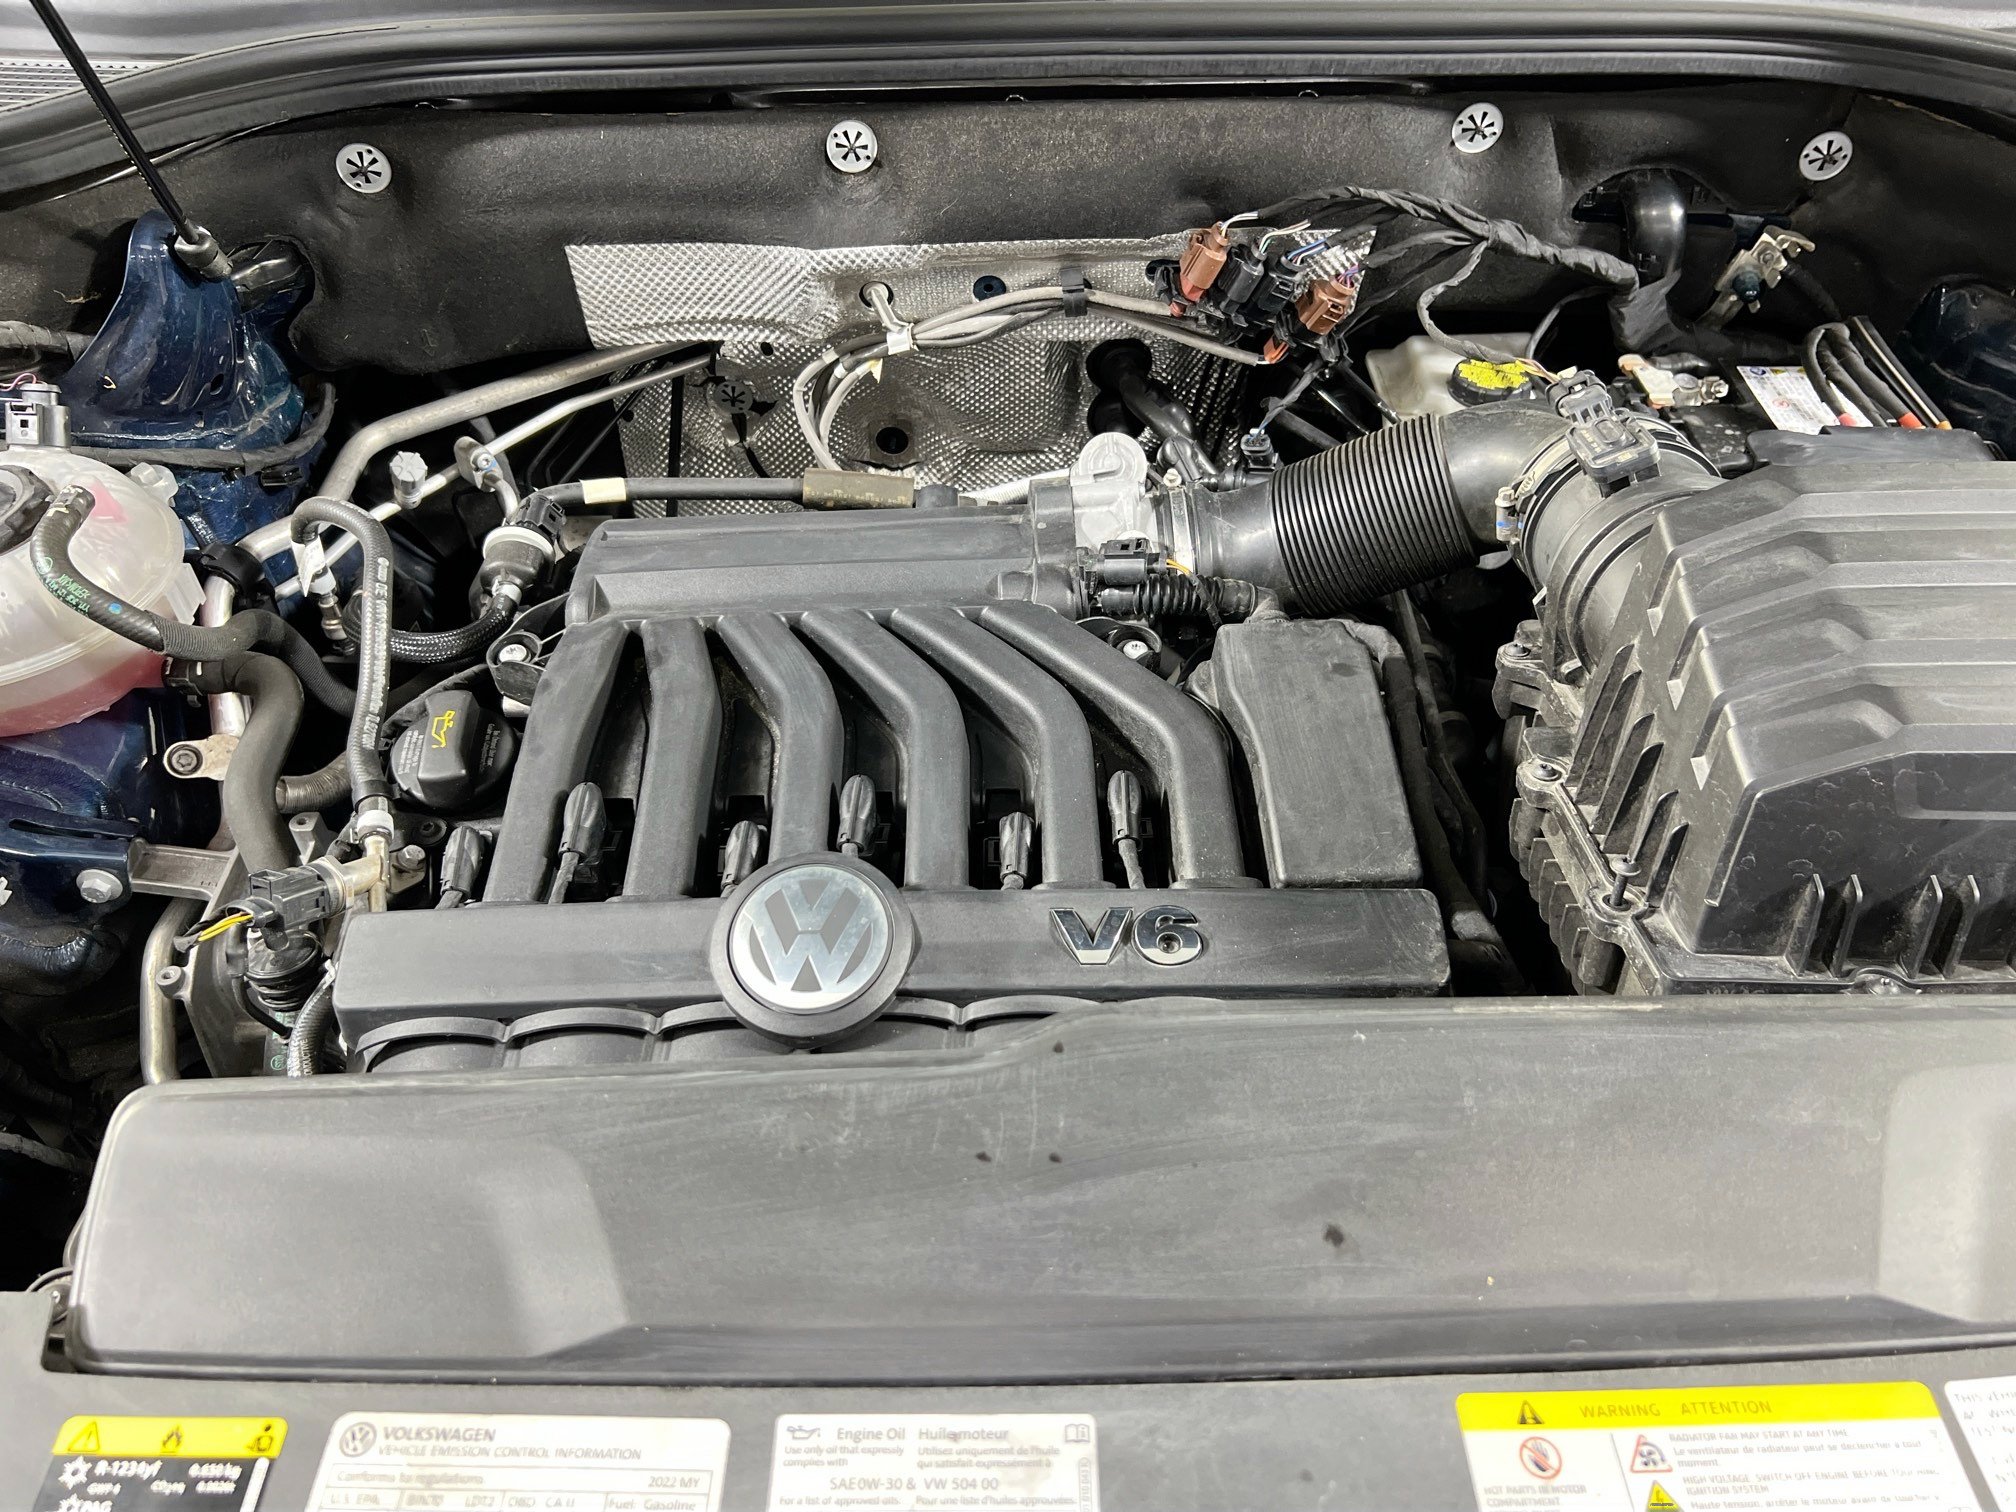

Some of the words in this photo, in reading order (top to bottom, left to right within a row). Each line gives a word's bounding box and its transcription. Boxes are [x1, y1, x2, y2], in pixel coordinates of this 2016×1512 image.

[1050, 906, 1203, 965] V6
[1579, 1403, 1661, 1418] WARNING
[1681, 1400, 1773, 1416] ATTENTION
[383, 1426, 496, 1442] VOLKSWAGEN
[837, 1426, 883, 1444] Engine
[886, 1426, 906, 1440] Oil
[957, 1428, 1009, 1440] moteur
[1762, 1430, 1790, 1439] START
[378, 1444, 427, 1456] VEHICLE
[430, 1445, 490, 1457] EMISSION
[494, 1446, 549, 1458] CONTROL
[555, 1447, 642, 1460] INFORMATION
[785, 1445, 802, 1454] Use
[803, 1445, 825, 1457] only
[825, 1445, 838, 1454] oil
[839, 1444, 859, 1455] that
[860, 1445, 905, 1458] expressly
[955, 1446, 1015, 1458] uniquement
[826, 1458, 849, 1467] with
[647, 1475, 677, 1488] 2022
[679, 1475, 701, 1488] MY
[905, 1476, 917, 1490] &
[923, 1477, 948, 1490] VW
[951, 1477, 977, 1490] 504
[981, 1477, 999, 1490] 00
[643, 1497, 697, 1511] Gasoline
[779, 1495, 794, 1505] For
[822, 1494, 833, 1505] of
